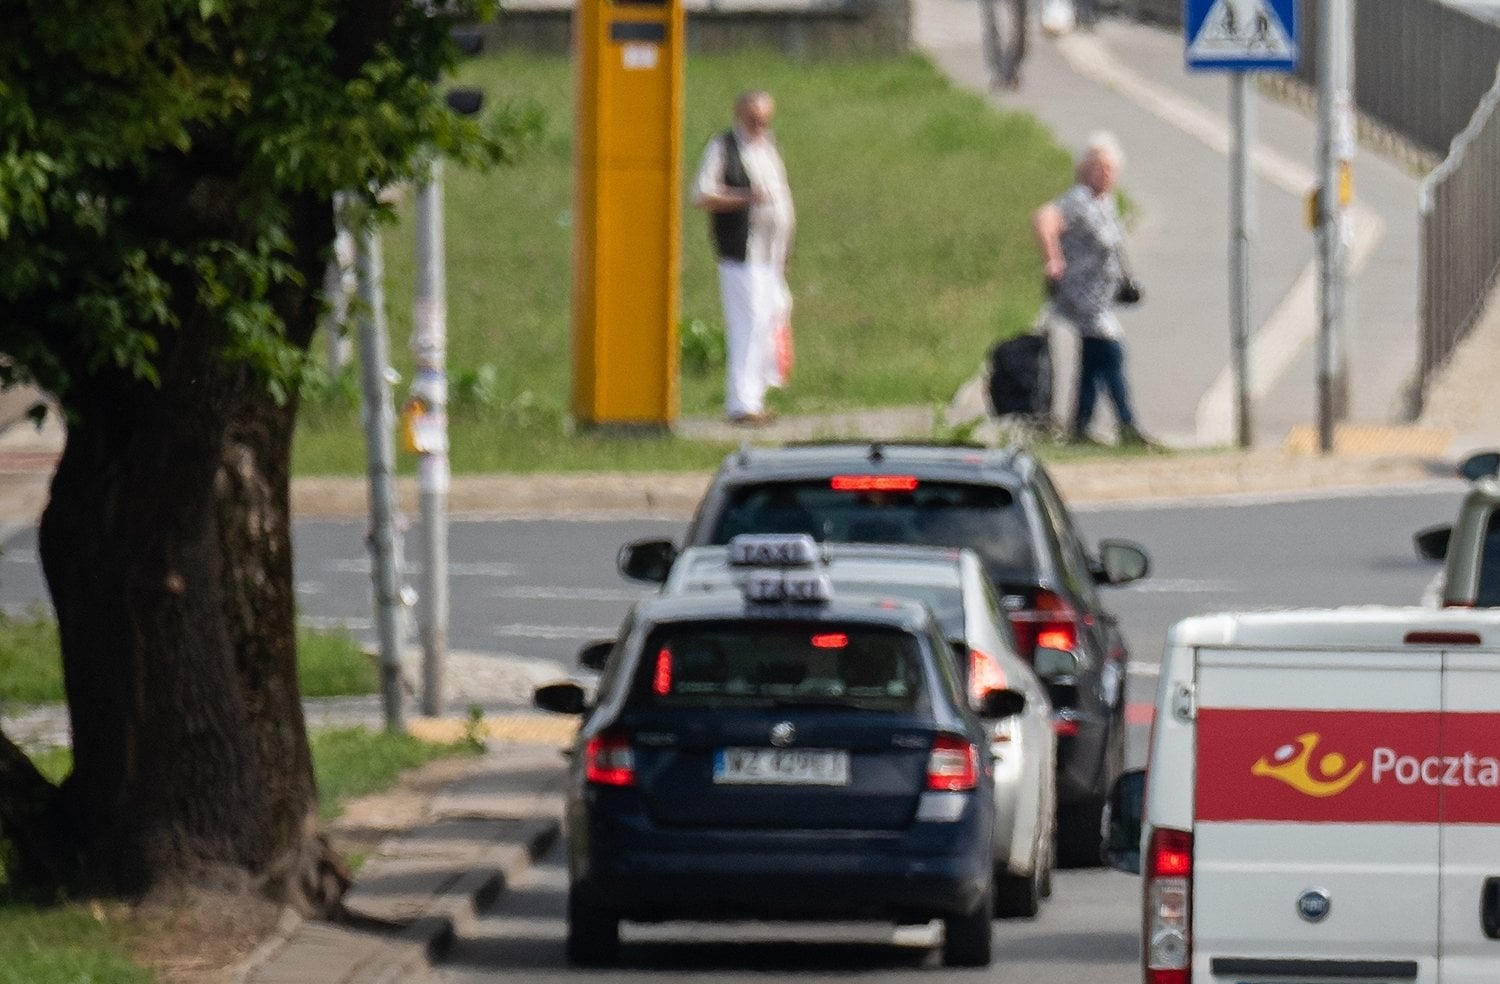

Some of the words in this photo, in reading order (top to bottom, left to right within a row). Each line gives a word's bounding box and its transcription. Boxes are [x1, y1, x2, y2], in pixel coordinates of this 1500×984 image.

[741, 543, 804, 562] TAXI
[757, 578, 819, 600] TAXI
[1371, 746, 1500, 787] Poczta
